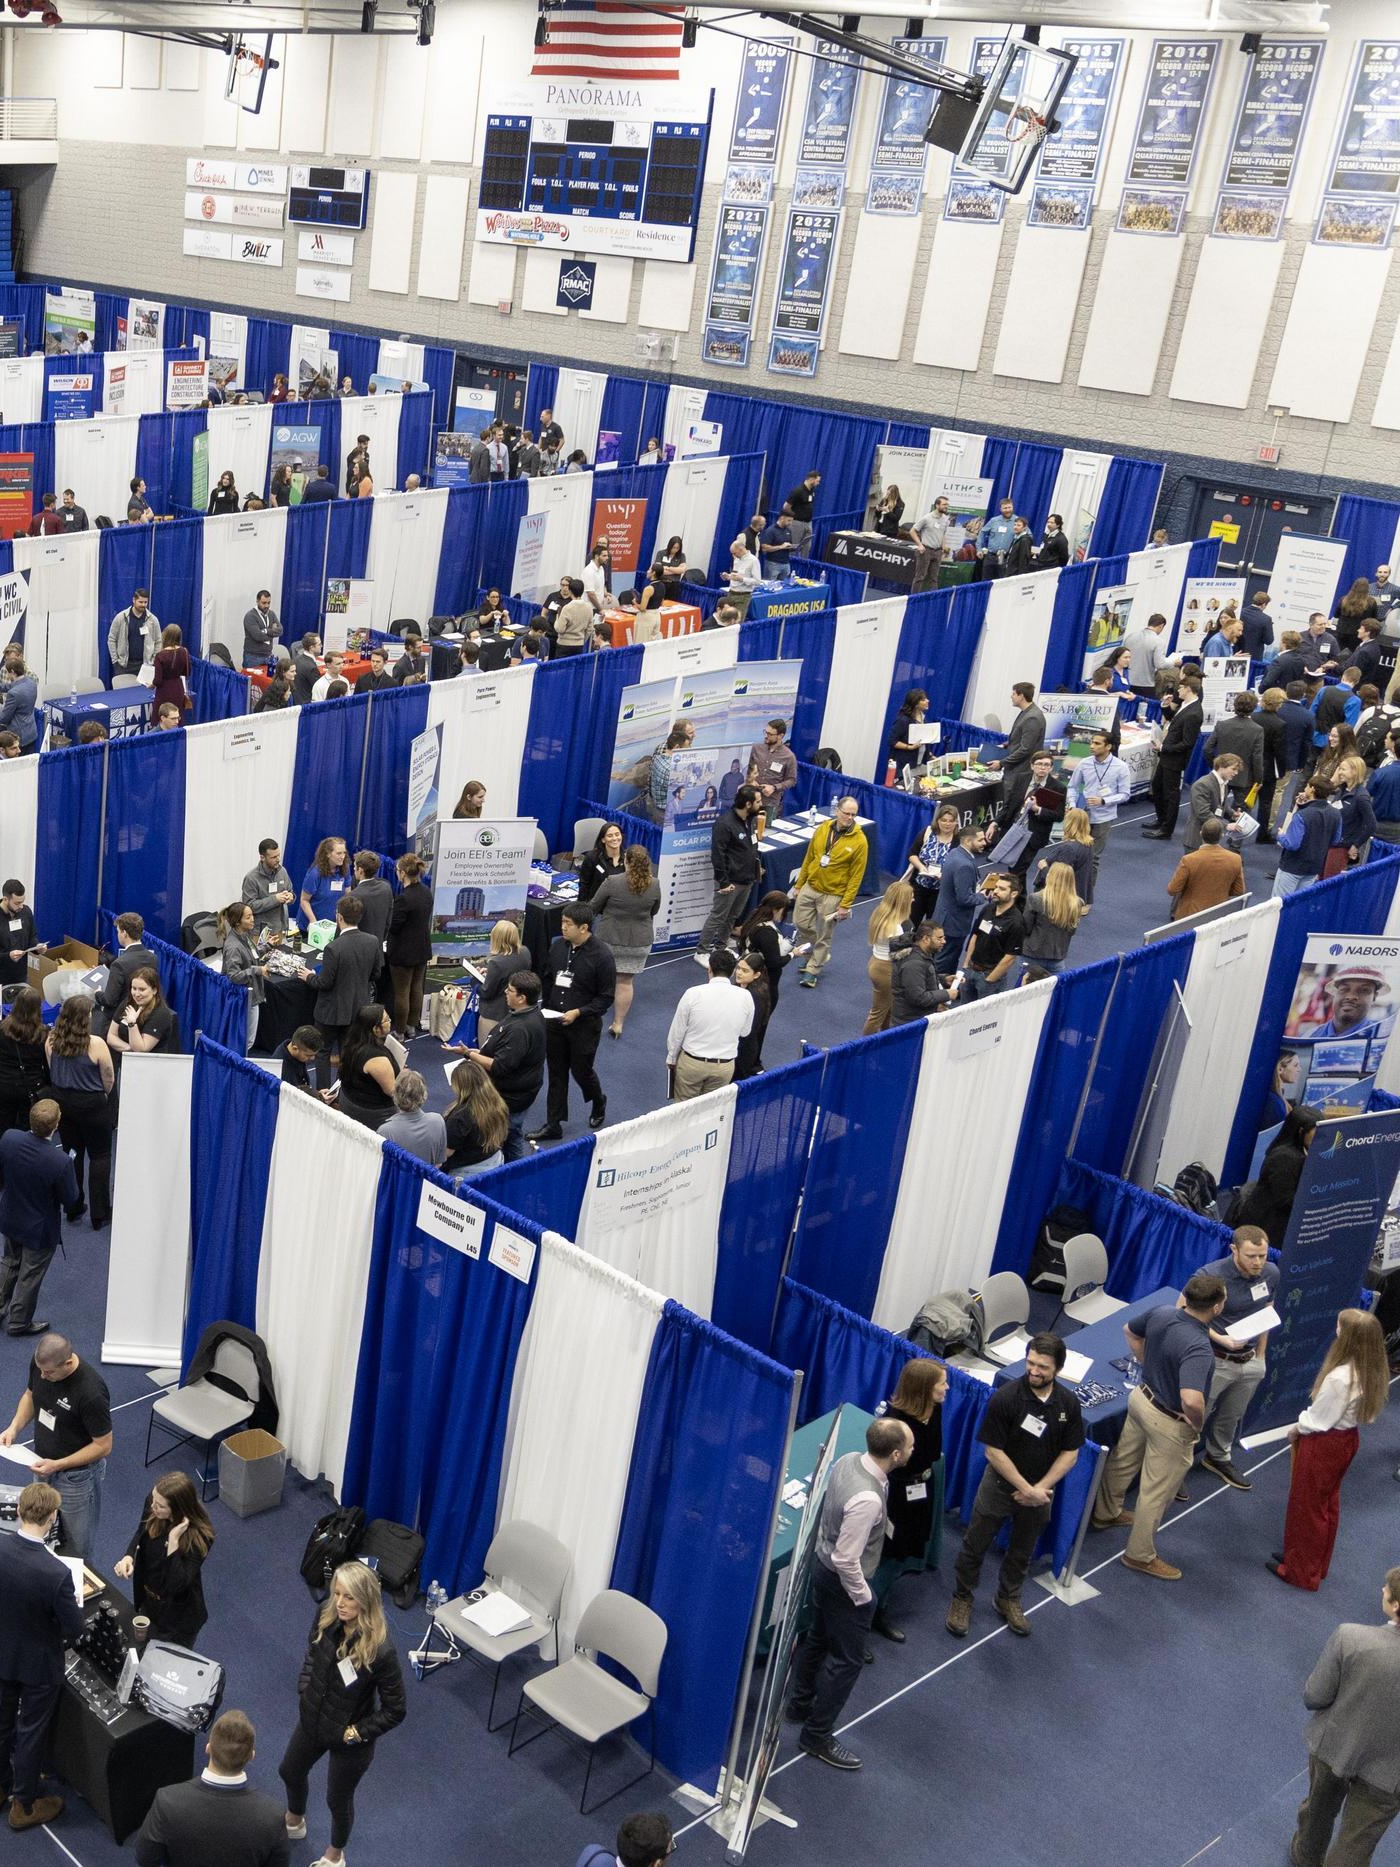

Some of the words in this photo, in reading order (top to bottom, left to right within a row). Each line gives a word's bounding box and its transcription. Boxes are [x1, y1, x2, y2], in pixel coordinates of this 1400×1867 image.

[900, 42, 934, 53] 2011
[1070, 45, 1112, 56] 2013
[1162, 46, 1208, 58] 2014
[1261, 47, 1312, 59] 2015
[1256, 64, 1283, 72] RECORD
[1285, 64, 1313, 72] RECORD
[546, 85, 642, 107] PANORAMA
[1166, 100, 1201, 108] CHAMPIONS
[1266, 102, 1303, 111] CHAMPIONS
[578, 151, 596, 160] PERIOD
[878, 152, 923, 160] SEMI-FINALIST
[1044, 150, 1096, 158] SEMI-FINALIST
[1135, 153, 1191, 162] QUARTERFINALIST
[1232, 158, 1292, 167] SEMI-FINALIST
[1338, 160, 1400, 171] SEMI-FINALIST
[532, 178, 546, 187] FOULS
[551, 179, 563, 187] T.O.L.
[568, 180, 586, 189] PLAYER
[586, 182, 600, 190] FOUL
[622, 184, 638, 192] FOULS
[528, 204, 544, 212] SCORE
[572, 208, 589, 216] MATCH
[619, 211, 636, 220] SCORE
[728, 210, 760, 222] 2021
[796, 216, 831, 228] 2022
[583, 224, 630, 237] COURTYARD
[636, 230, 676, 242] Residence
[242, 241, 271, 258] BUILT
[563, 278, 589, 292] RMAC
[780, 305, 820, 316] SEMI-FINALIST
[172, 384, 204, 392] ARCHITECTURE
[292, 432, 318, 442] AGW
[1260, 447, 1276, 458] EXIT
[944, 483, 984, 493] LITHOS
[607, 504, 636, 520] wsp
[526, 518, 543, 533] wsp
[854, 546, 911, 567] ZACHRY
[4, 584, 17, 601] WC
[4, 598, 22, 620] CIVIL
[768, 601, 809, 618] DRAGADOS
[810, 600, 825, 611] USA
[1042, 704, 1112, 715] SEABOARD
[673, 836, 698, 848] SOLAR
[444, 850, 466, 860] Join
[469, 850, 492, 859] EEI's
[496, 849, 526, 859] Team!
[484, 862, 514, 870] Ownership
[450, 870, 472, 878] Flexible
[490, 870, 515, 878] Schedule
[1346, 945, 1398, 959] NABORS
[969, 1026, 982, 1036] Chord
[983, 1022, 998, 1032] Energy
[617, 1168, 647, 1183] Hilcorp
[650, 1160, 672, 1175] Energy
[672, 1144, 702, 1162] Company
[624, 1180, 662, 1198] Internships
[664, 1177, 670, 1185] in
[670, 1164, 693, 1180] Alaska!
[1310, 1184, 1326, 1194] Our
[1330, 1178, 1360, 1190] Mission
[428, 1194, 464, 1222] Mewbourne
[466, 1214, 476, 1226] Oil
[434, 1210, 464, 1233] Company
[466, 1243, 478, 1255] L45
[502, 1247, 520, 1263] FEATURED
[502, 1253, 519, 1268] SPONSOR
[1290, 1264, 1306, 1275] Our
